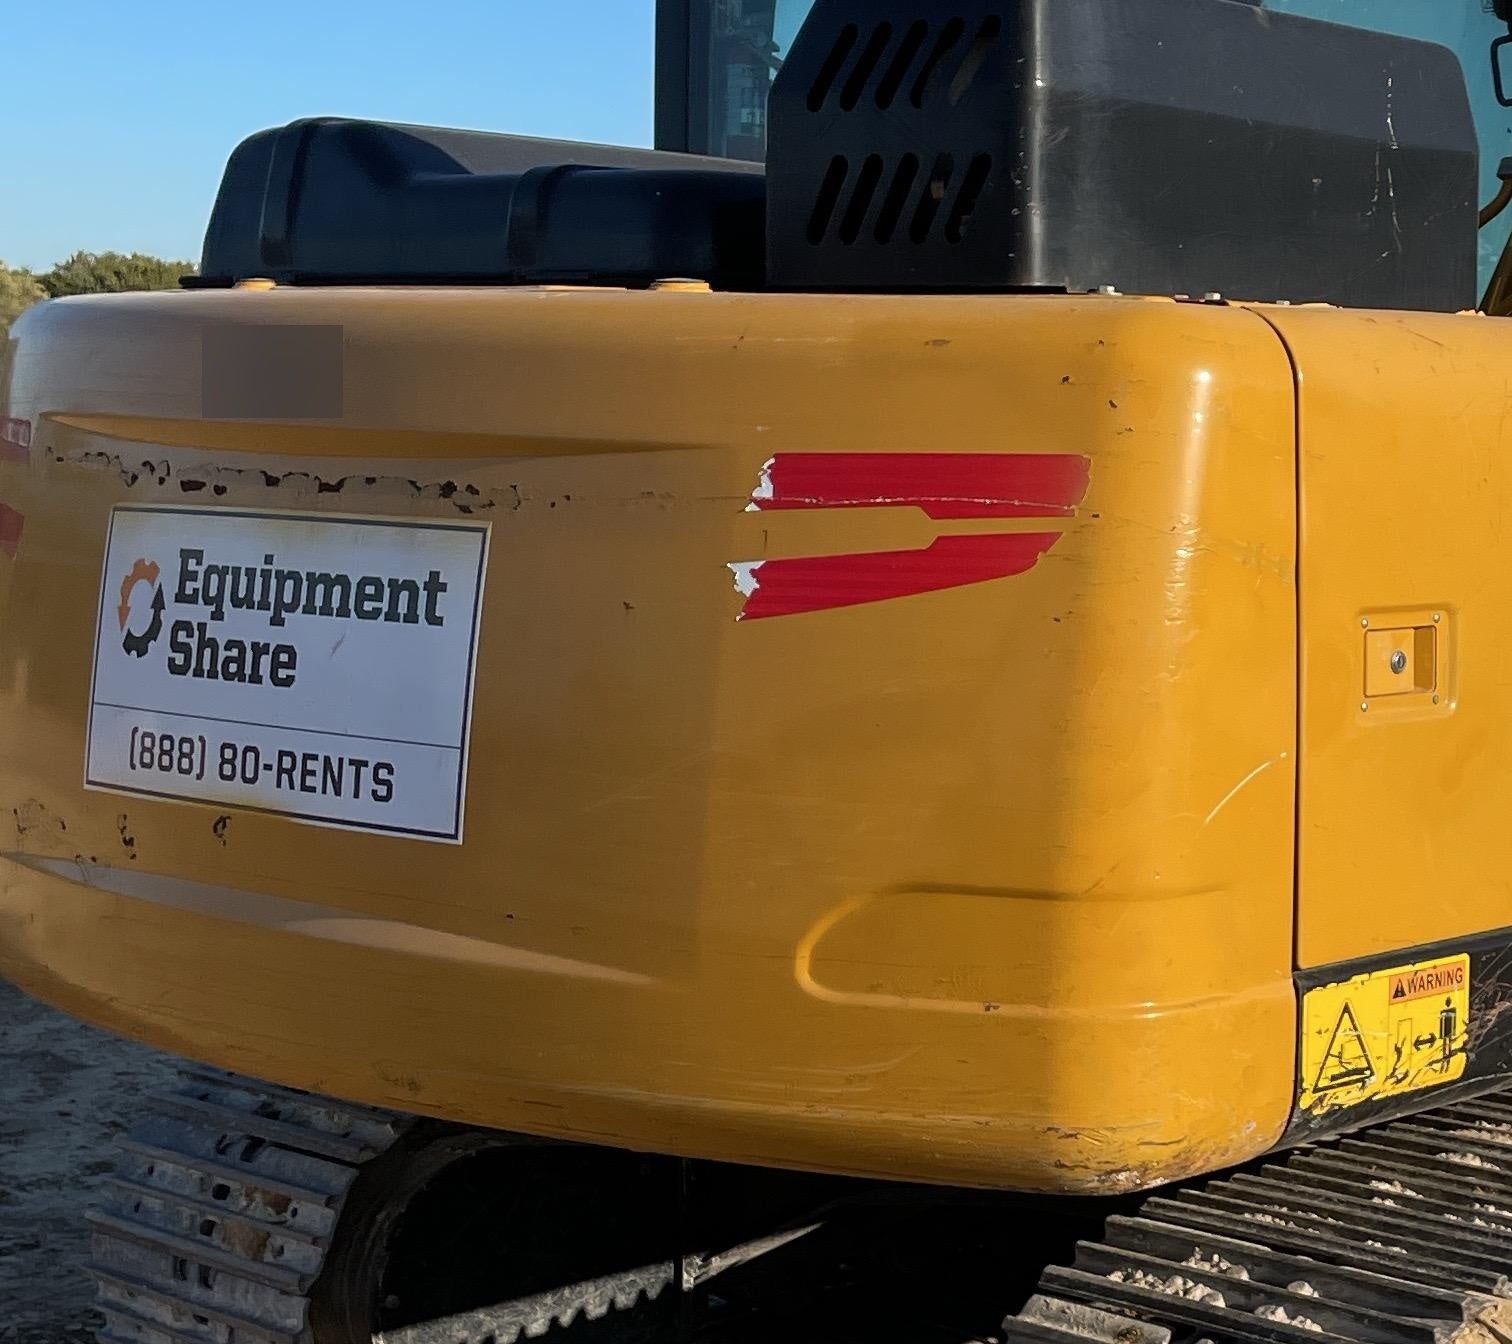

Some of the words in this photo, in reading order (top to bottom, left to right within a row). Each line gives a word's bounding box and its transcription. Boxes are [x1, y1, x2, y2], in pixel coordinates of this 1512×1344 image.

[174, 548, 448, 626] Equipment
[167, 620, 298, 688] Share
[129, 726, 206, 781] (888)
[218, 742, 395, 803] 80-RENTS
[1407, 968, 1463, 994] WARNING
